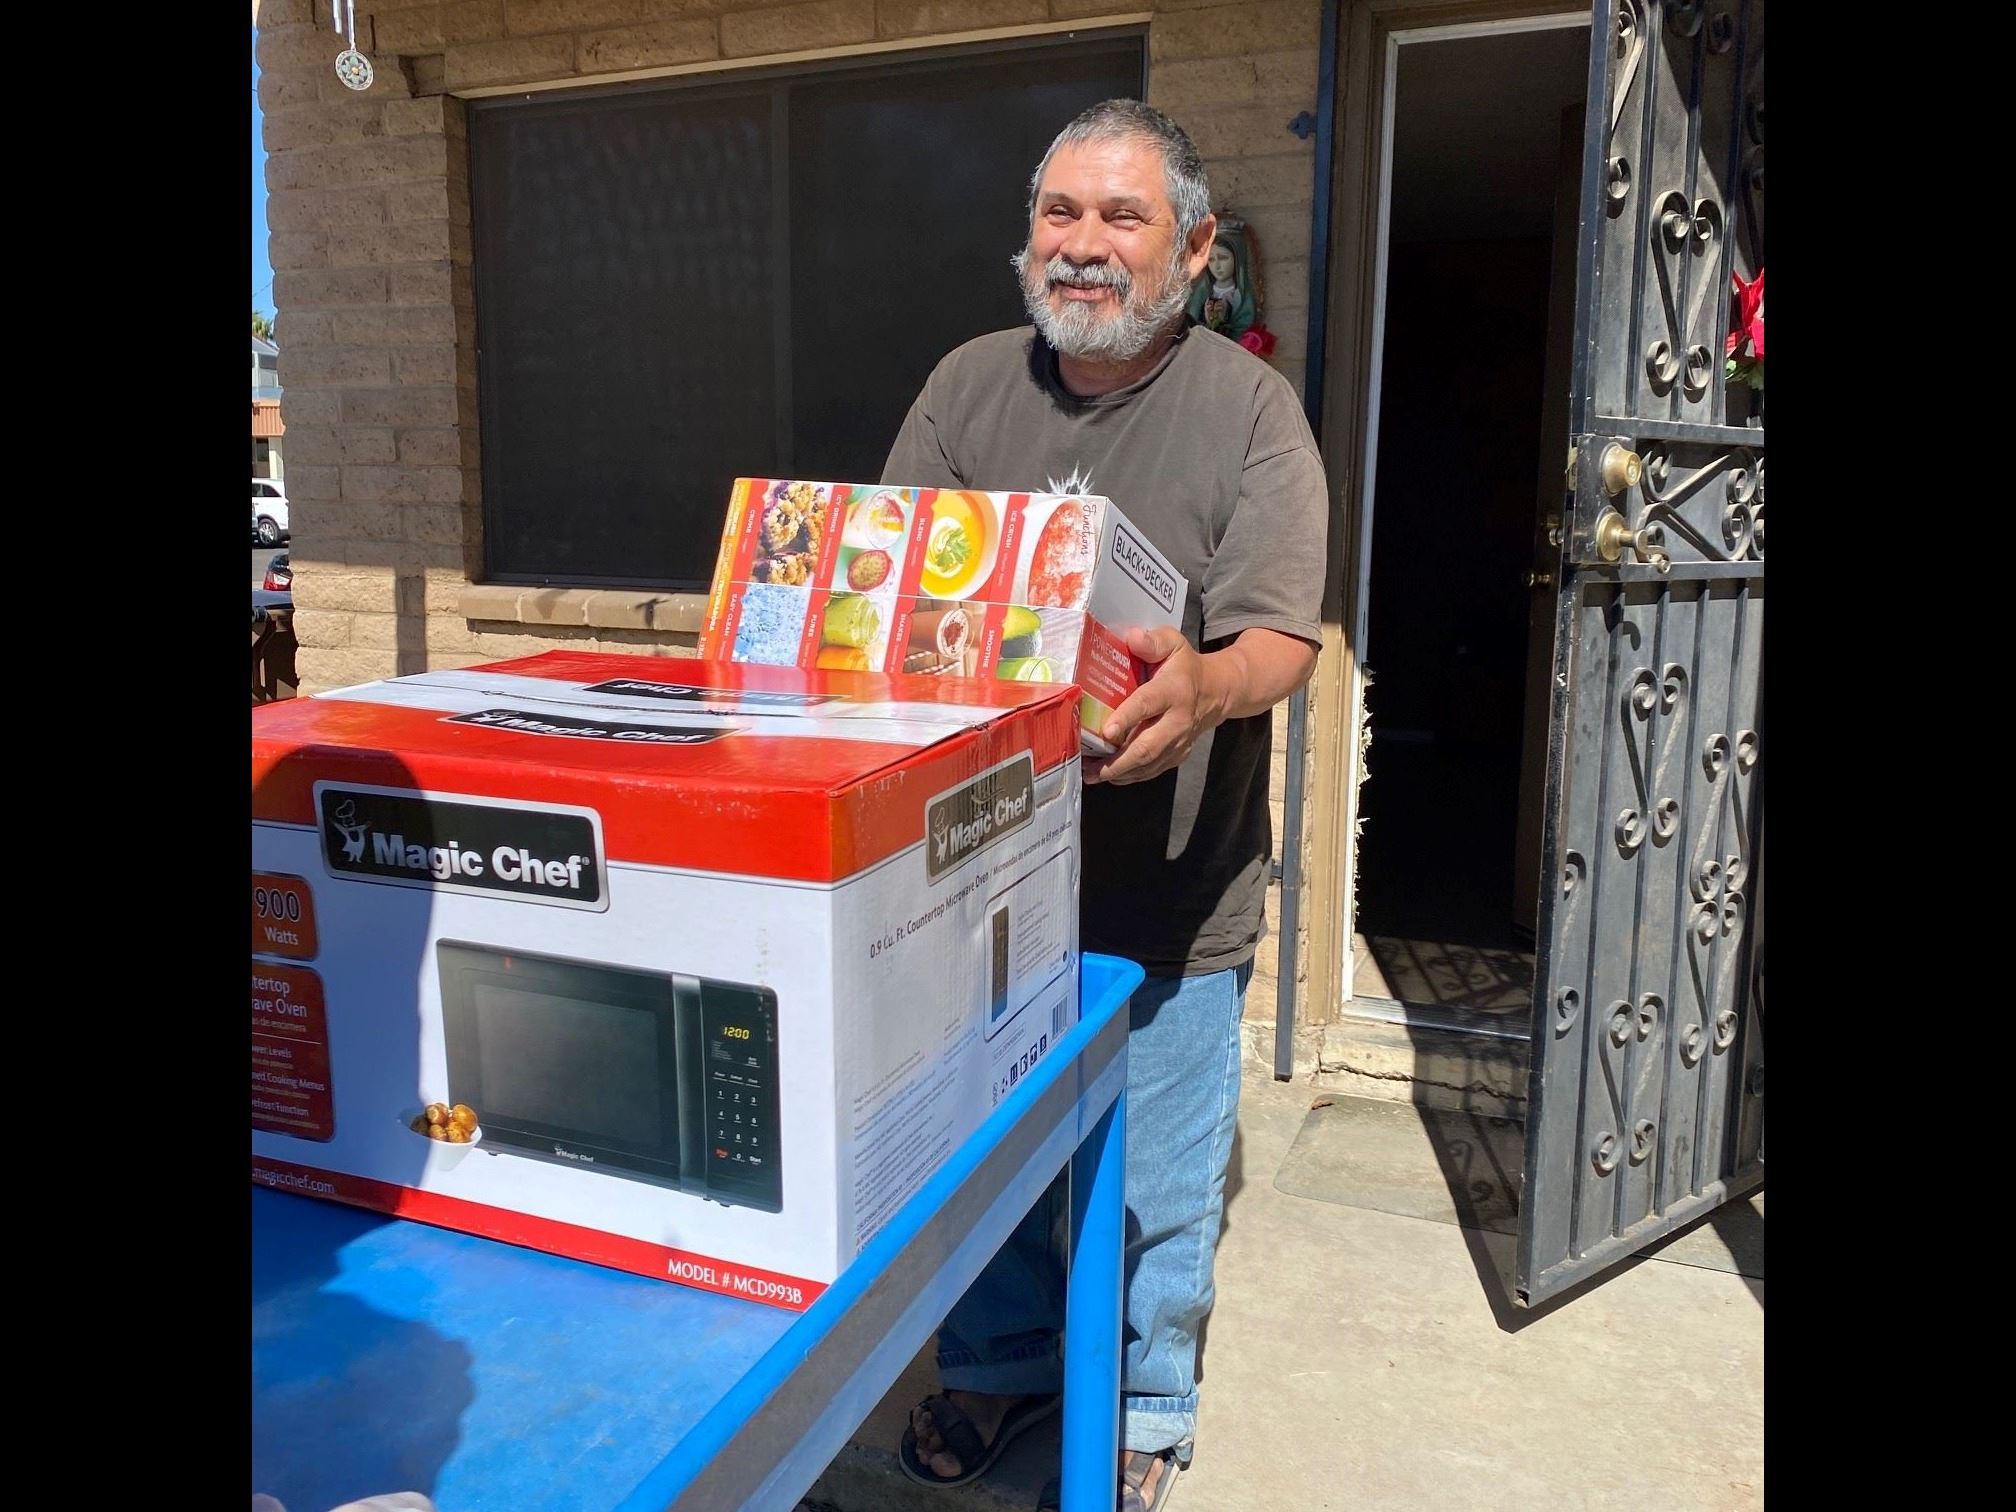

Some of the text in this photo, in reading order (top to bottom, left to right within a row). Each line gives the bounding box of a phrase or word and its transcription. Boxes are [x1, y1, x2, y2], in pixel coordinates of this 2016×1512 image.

[829, 507, 840, 533] DRINKS
[916, 517, 927, 542] BLEND
[1005, 510, 1018, 548] ICE CRUSH
[1080, 504, 1097, 556] Functions
[1115, 535, 1174, 604] BLACK+DECKER
[724, 593, 738, 637] EASY CLEAN
[895, 613, 907, 642] SHAKES
[982, 629, 995, 669] SMOOTHIE
[613, 681, 692, 696] Chef
[504, 717, 710, 742] Magic Chef
[949, 786, 1028, 856] Magic Chef
[372, 832, 582, 889] Magic Chef
[255, 886, 301, 922] 900
[870, 940, 882, 959] 0.9
[883, 933, 895, 950] Cu.
[896, 926, 906, 943] Ft.
[907, 906, 945, 936] Countertop
[945, 880, 975, 911] Microwave
[975, 871, 989, 888] Oven
[264, 926, 299, 945] Watts
[275, 998, 308, 1018] Oven
[561, 1150, 594, 1162] Magic Chef
[749, 1155, 762, 1163] Start
[668, 1258, 803, 1304] MODEL # MCD993B
